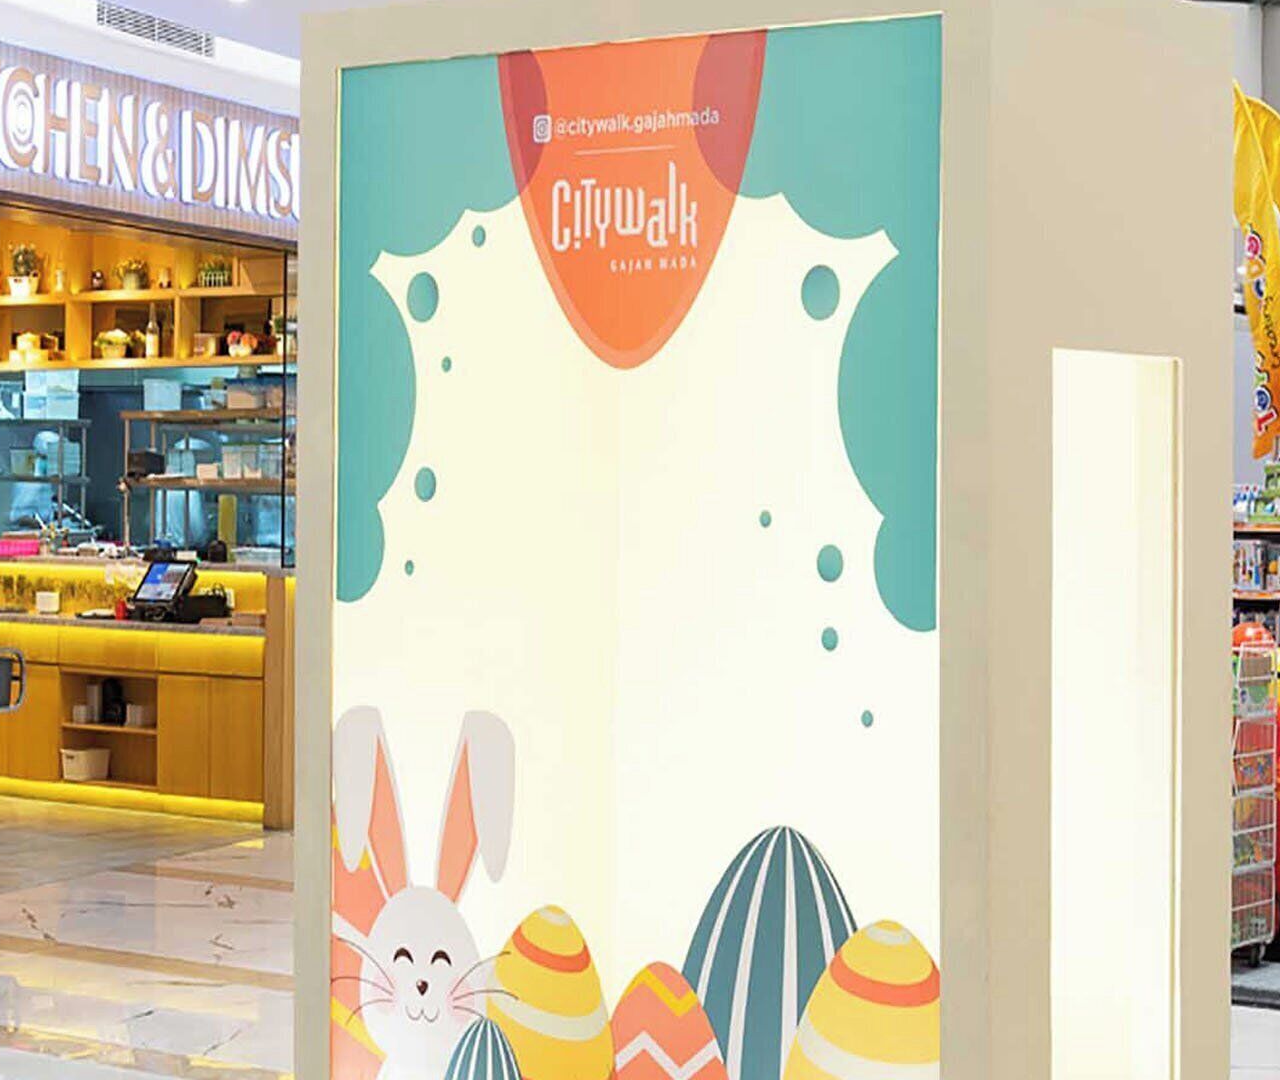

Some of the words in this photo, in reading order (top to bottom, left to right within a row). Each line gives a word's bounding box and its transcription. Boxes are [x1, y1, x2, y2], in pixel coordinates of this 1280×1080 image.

[554, 107, 720, 138] @citywalk.gajahmada
[141, 102, 175, 199] &
[610, 259, 652, 274] GAJAH
[659, 256, 697, 270] MADA
